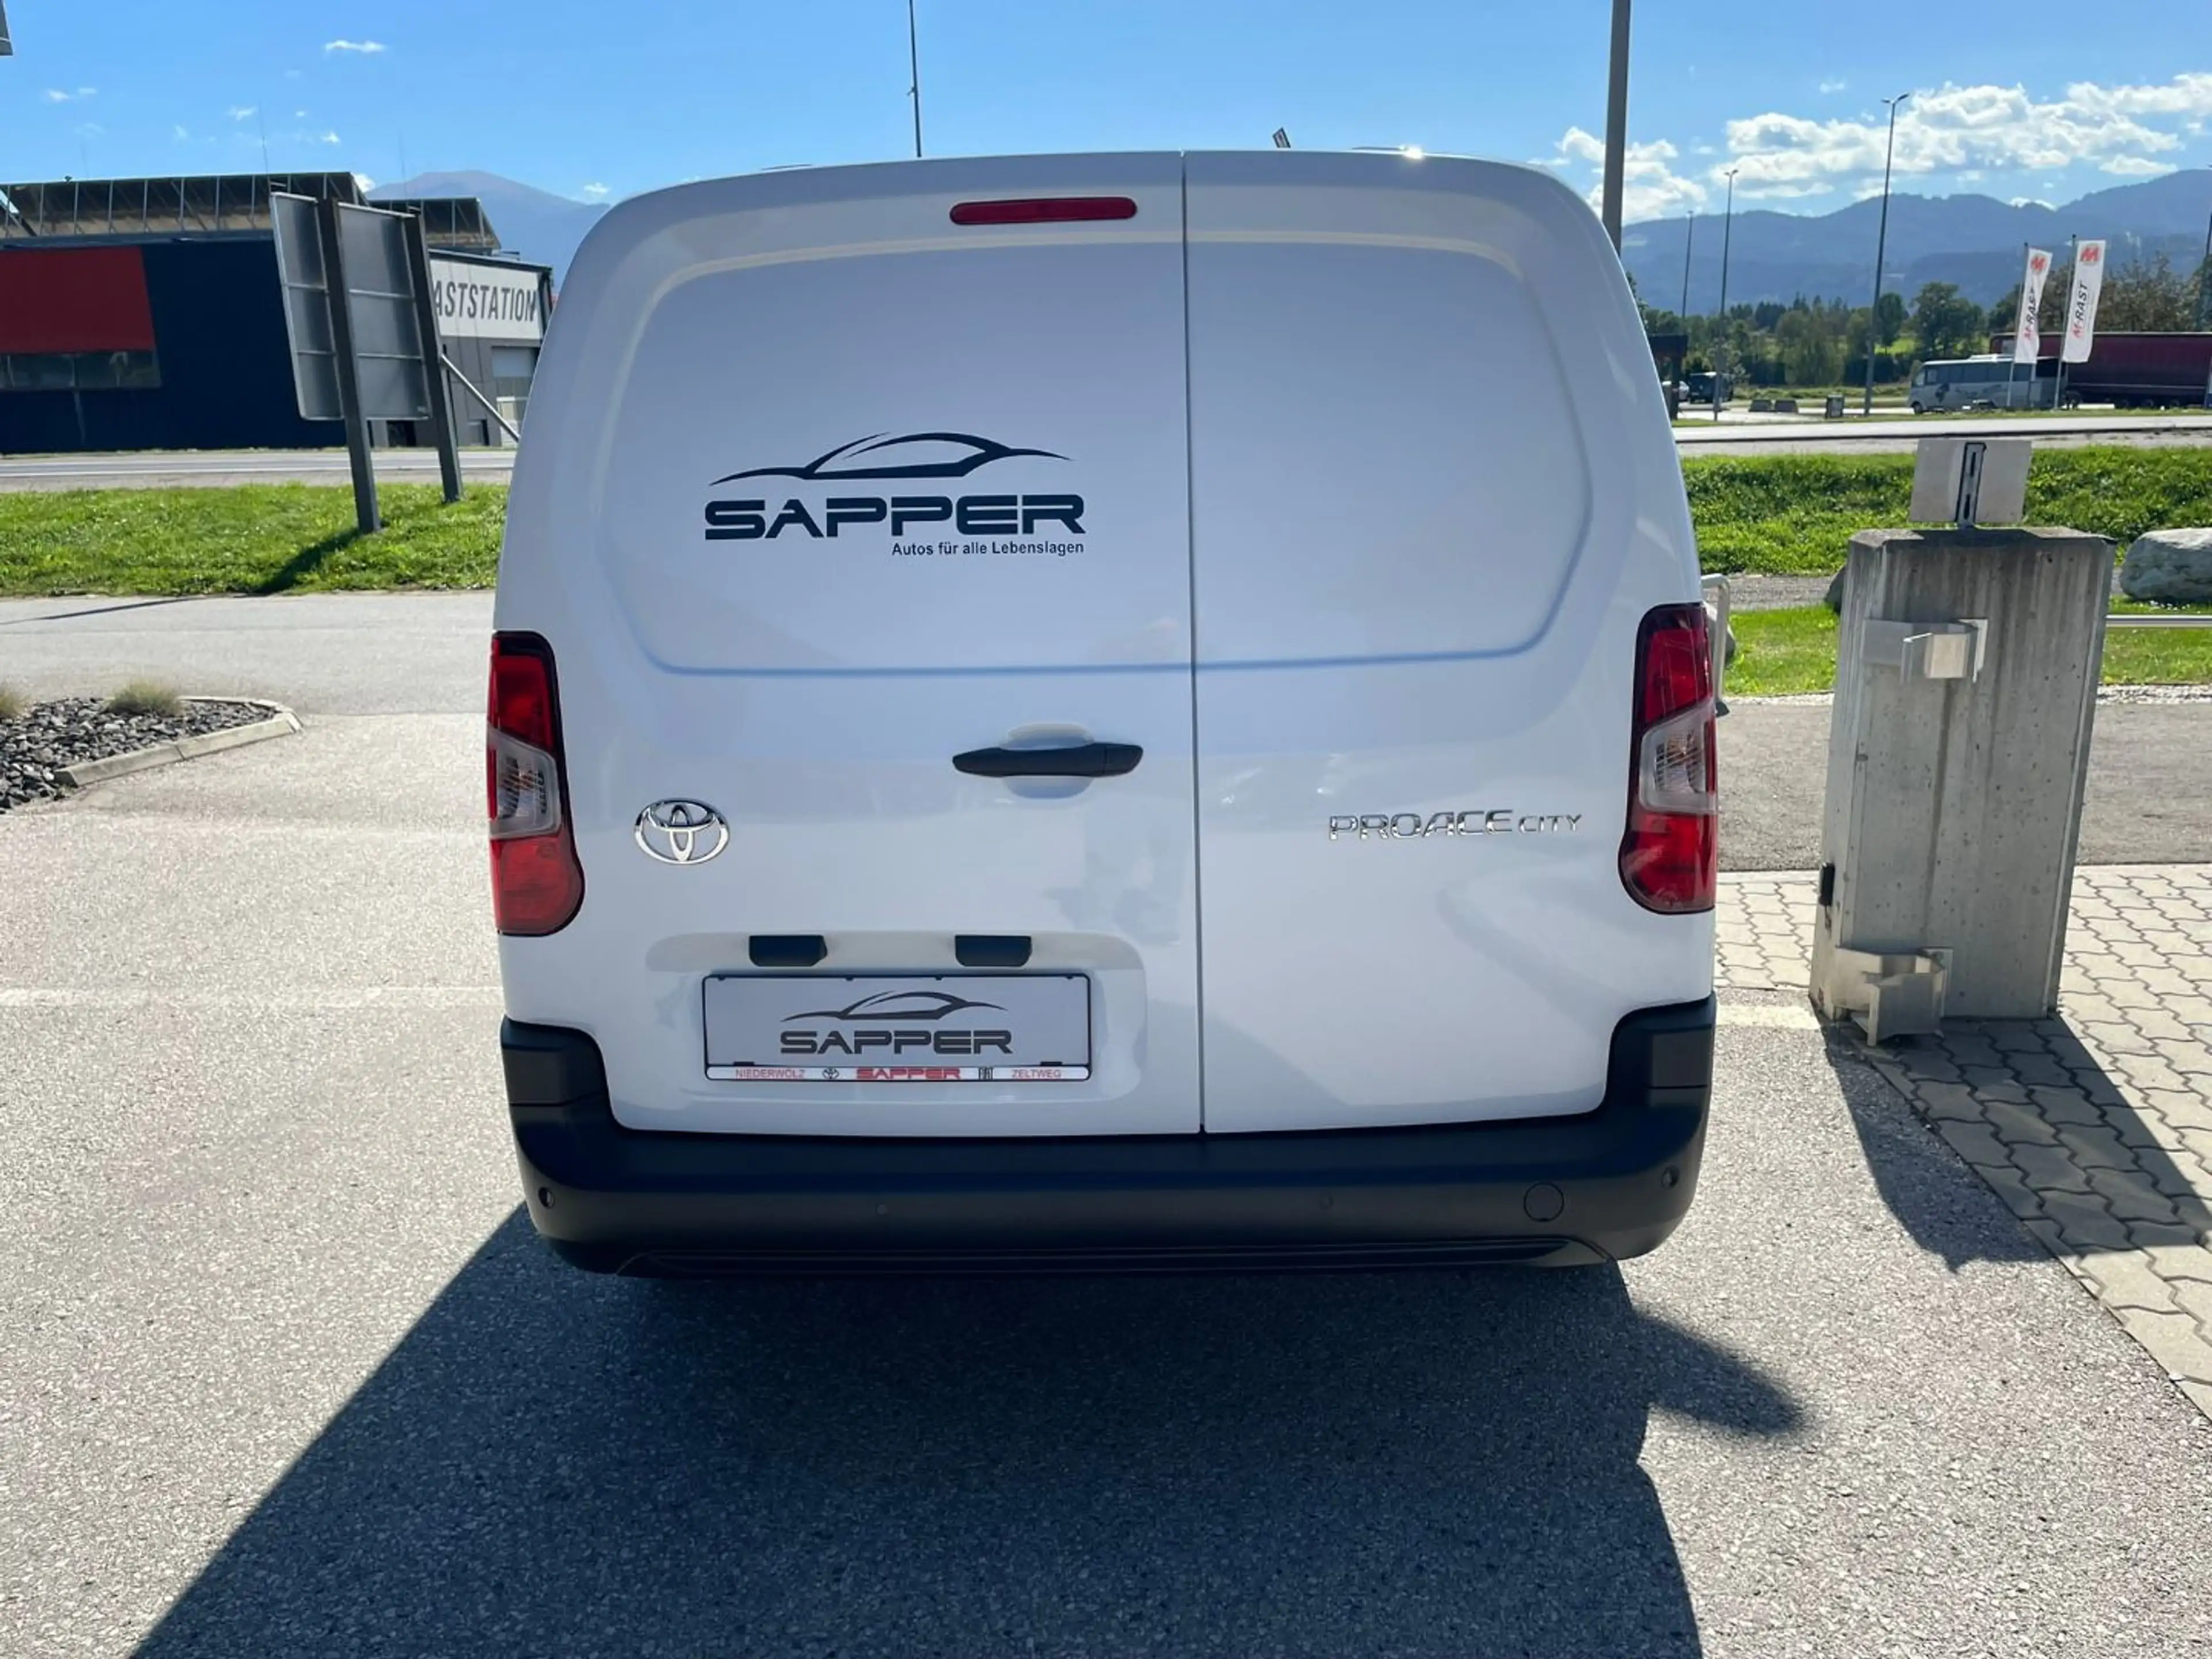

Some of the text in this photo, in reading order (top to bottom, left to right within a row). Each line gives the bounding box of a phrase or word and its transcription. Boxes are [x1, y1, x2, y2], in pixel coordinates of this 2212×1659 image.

[433, 280, 536, 321] ASTSTATION
[705, 494, 1085, 540] SAPPER
[892, 540, 1085, 557] Autos für alle Lebenslagen
[1329, 810, 1582, 840] PROACE CITY
[780, 1030, 1013, 1054] SAPPER
[856, 1067, 961, 1080] SAPPER
[1012, 1069, 1062, 1078] ZELTWEG
